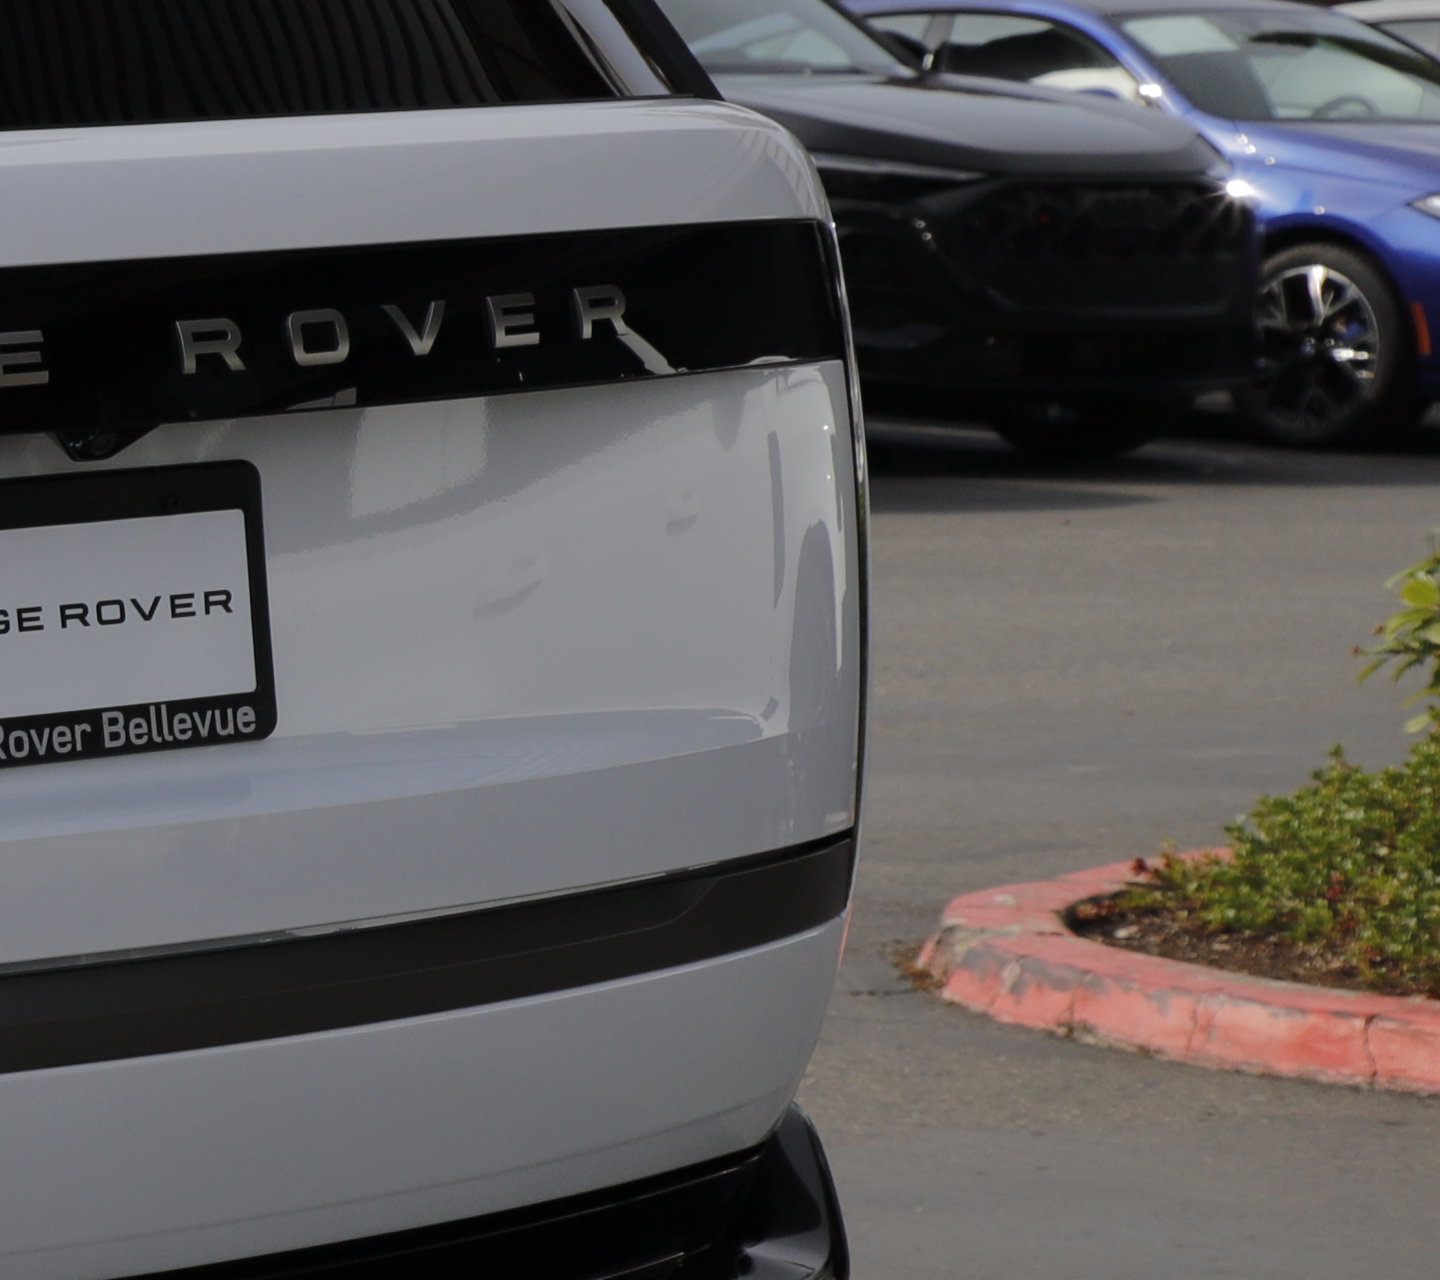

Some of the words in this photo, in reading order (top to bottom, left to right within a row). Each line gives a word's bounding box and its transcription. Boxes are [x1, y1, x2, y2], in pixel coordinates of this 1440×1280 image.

[174, 284, 630, 375] ROVER
[60, 589, 233, 629] ROVER
[102, 704, 256, 748] Bellevue
